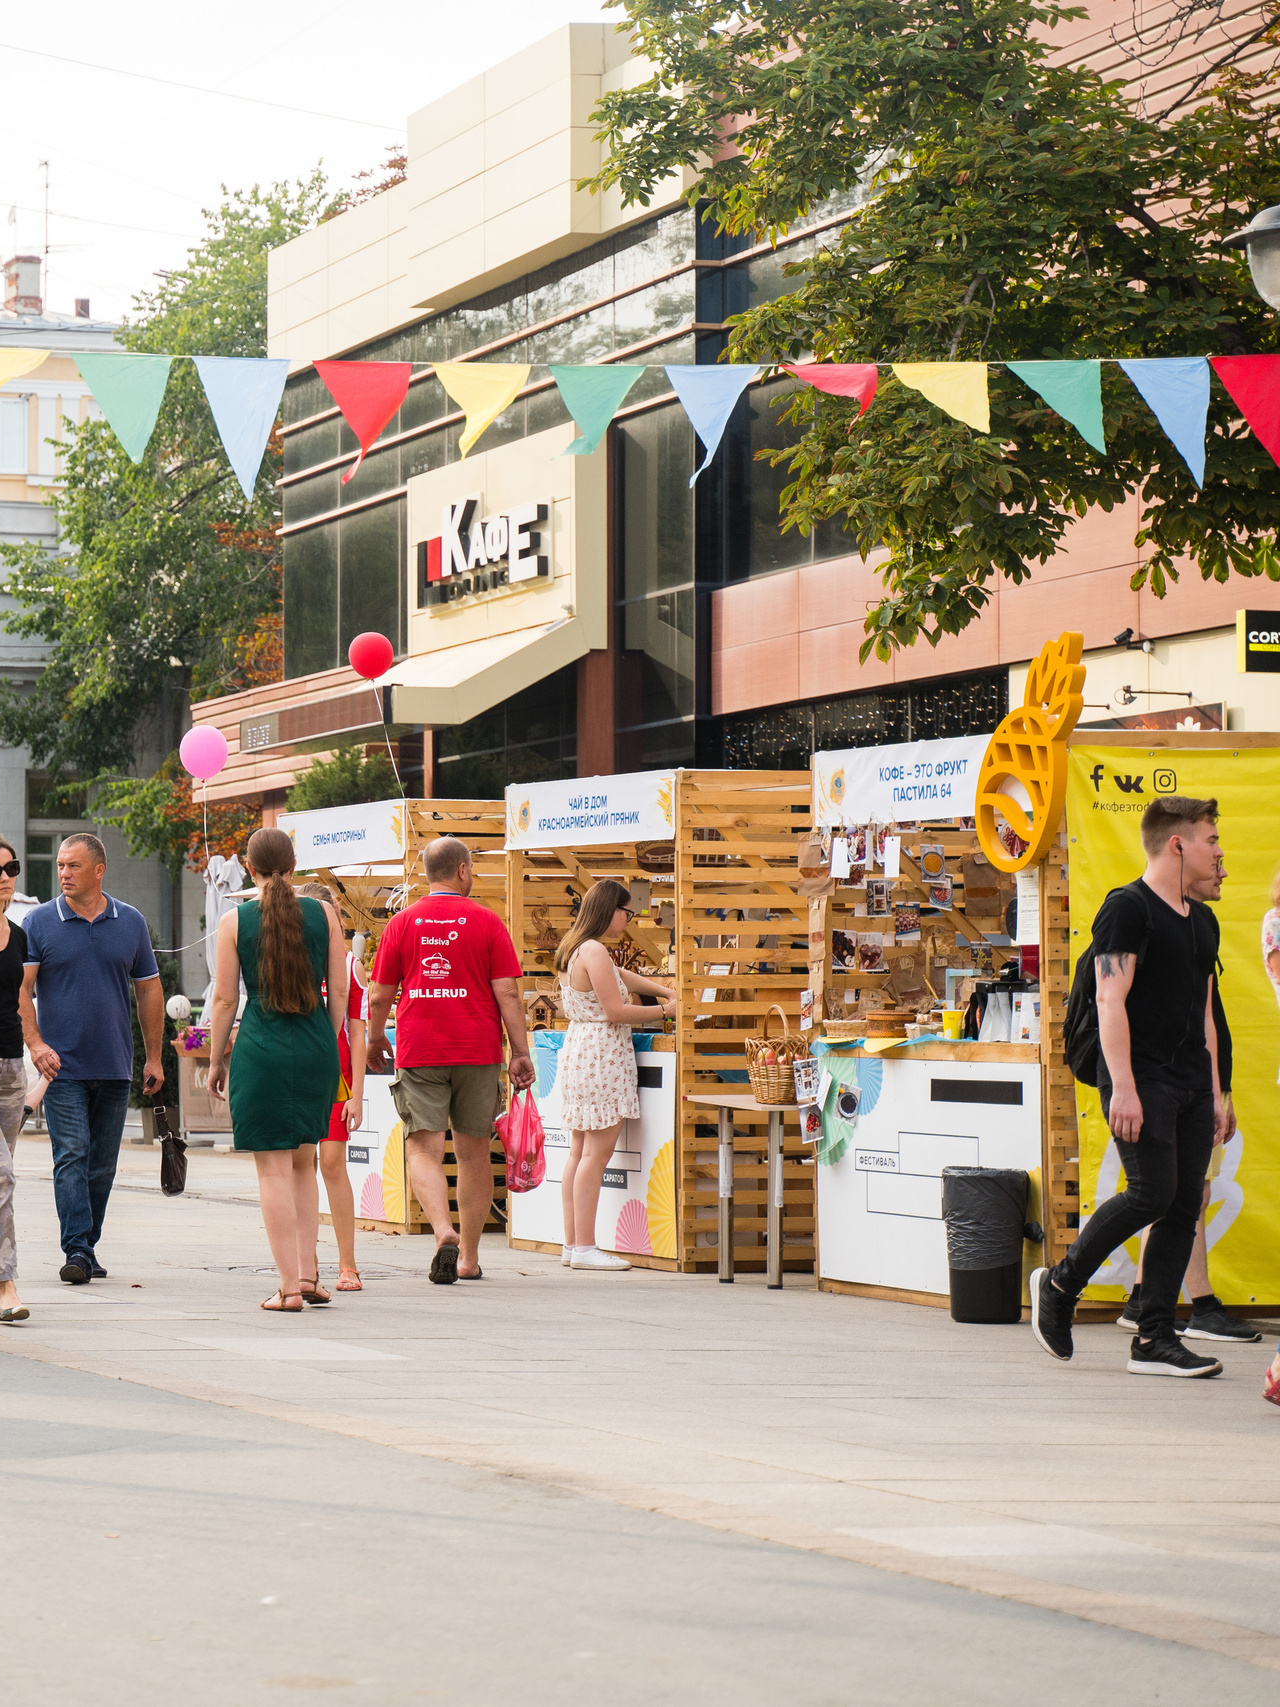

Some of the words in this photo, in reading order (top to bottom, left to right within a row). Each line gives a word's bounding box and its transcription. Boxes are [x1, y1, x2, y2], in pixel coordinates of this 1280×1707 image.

[441, 500, 544, 583] КАФЕ
[1249, 631, 1280, 644] COR
[880, 766, 904, 781] КОФЕ
[914, 763, 932, 778] ЭТО
[935, 760, 968, 776] ФРУКТ
[893, 784, 938, 802] ПАСТИЛА
[941, 783, 951, 798] 64
[569, 795, 582, 810] ЧАЙ
[584, 797, 589, 809] В
[591, 795, 607, 811] ДОМ
[539, 811, 608, 831] КРАСНОАРМЕЙСКИЙ
[611, 811, 639, 826] ПРЯНИК
[313, 834, 330, 846] СЕМЬЯ
[331, 829, 366, 843] МОТОРИНЫХ
[421, 936, 450, 946] Eidsiva
[409, 988, 468, 999] BILLERUD
[350, 1150, 368, 1160] САРАТОВ
[859, 1155, 896, 1168] ФЕСТИВАЛЬ
[603, 1173, 624, 1184] САРАТОВ
